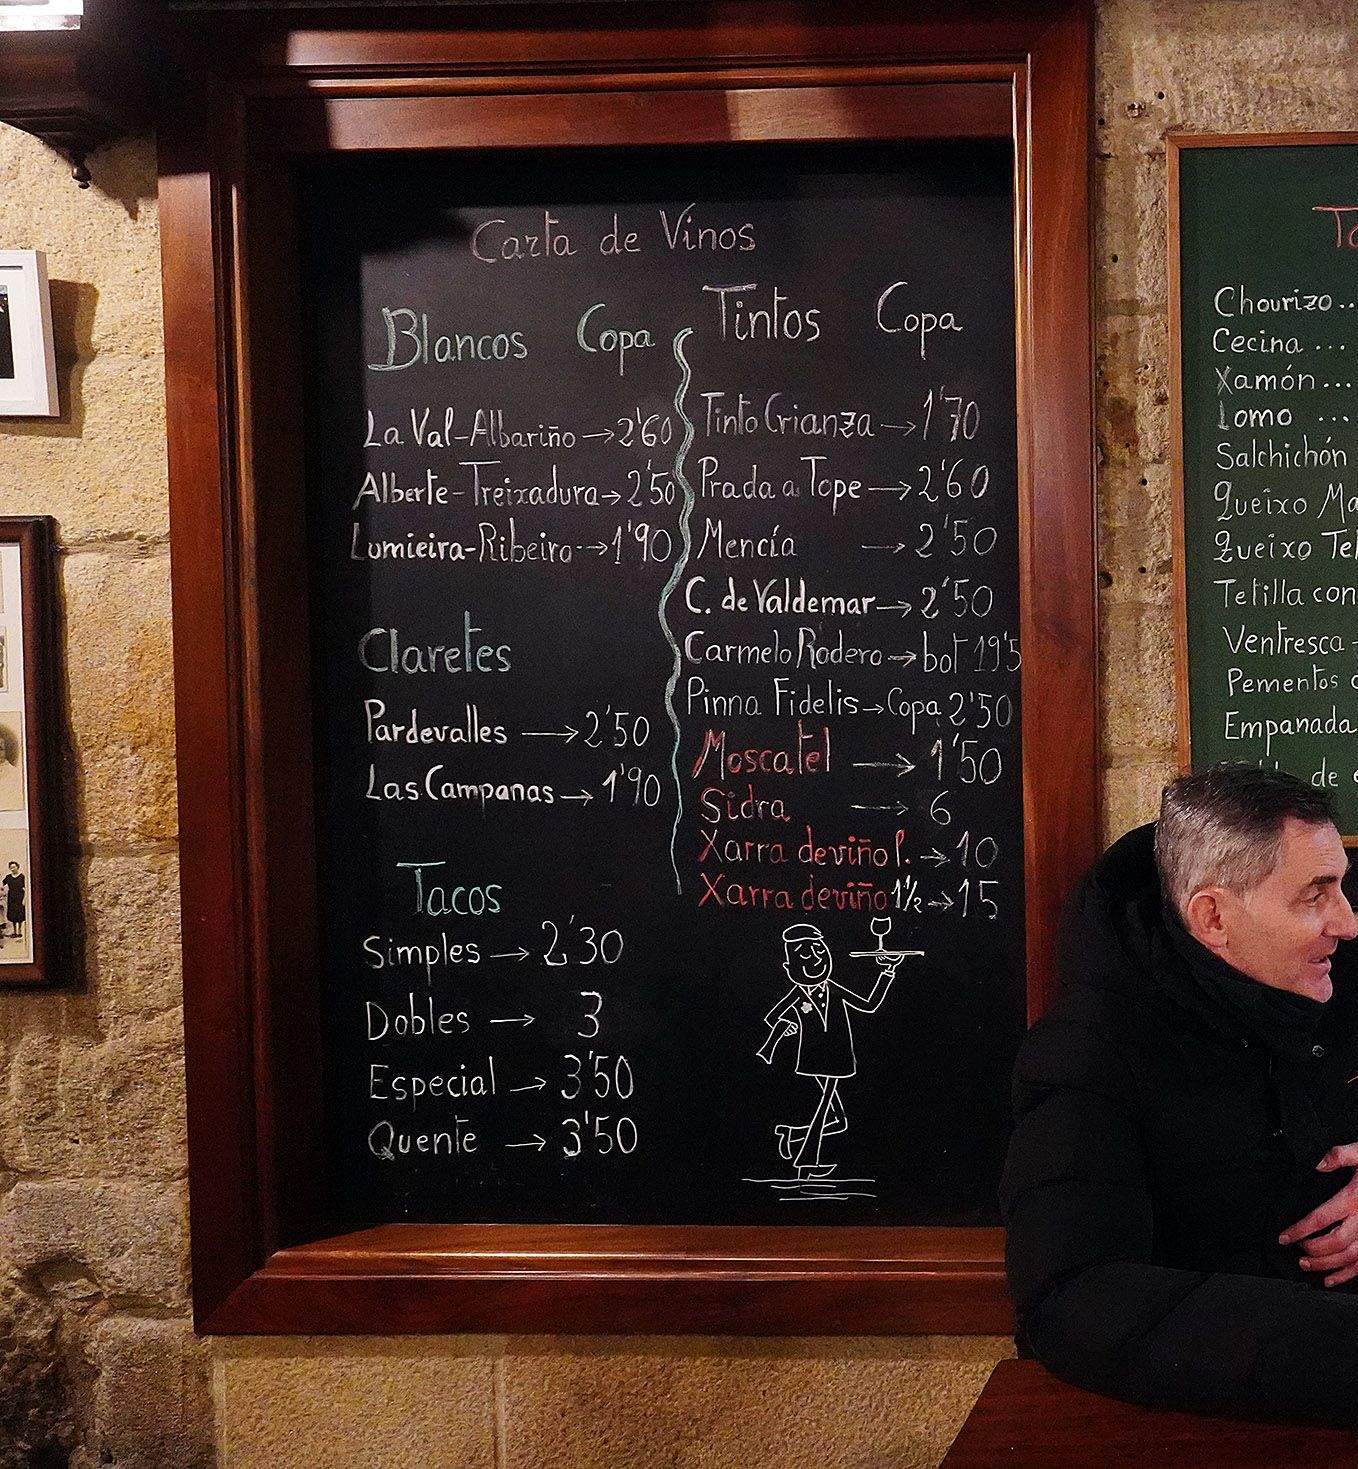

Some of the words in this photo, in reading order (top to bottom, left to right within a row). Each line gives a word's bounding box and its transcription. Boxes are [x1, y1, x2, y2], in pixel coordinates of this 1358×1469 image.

[471, 211, 577, 263] Carta
[600, 213, 641, 255] de
[660, 203, 756, 250] Vinos
[367, 307, 528, 370] Blancos
[576, 303, 656, 376] Copa
[702, 284, 821, 341] Tintos
[877, 281, 963, 360] Copa
[1213, 328, 1303, 354] Cecina
[363, 411, 399, 448] La
[701, 392, 758, 437] Tinto
[765, 393, 875, 438] Crianza
[1217, 400, 1292, 430] Lomo
[1216, 435, 1348, 470] Salchichón
[698, 456, 776, 499] Prada
[784, 479, 800, 497] a
[801, 456, 862, 516] Tope
[697, 517, 798, 560] Mencía
[685, 577, 711, 615] C.
[721, 577, 748, 611] de
[753, 577, 876, 616] Valdemar
[1213, 577, 1305, 607] Tetilla
[1313, 585, 1356, 606] con
[358, 610, 512, 673] Claretes
[684, 629, 792, 665] Carmelo
[796, 628, 882, 669] Rodero
[923, 631, 968, 674] bot
[1222, 620, 1345, 656] Ventresca
[1227, 664, 1338, 696] Pementos
[363, 699, 508, 744] Pardevalles
[583, 704, 650, 748] 2'50
[687, 677, 761, 716] Pinna
[774, 678, 859, 716] Fidelis
[888, 688, 942, 735] Copa
[949, 691, 1013, 729] 2'50
[692, 719, 831, 781] Moscatel
[1224, 706, 1357, 756] Empanada
[366, 764, 419, 800] Las
[425, 765, 555, 815] Campanas
[1311, 757, 1338, 788] de
[700, 784, 791, 824] Sidra
[930, 790, 951, 825] 6
[699, 829, 784, 864] Xarra
[957, 831, 999, 868] 10
[396, 861, 502, 916] Tacos
[699, 872, 793, 908] Xarra
[958, 878, 999, 920] 15
[363, 933, 481, 986] Simples
[542, 915, 624, 966] 2'30
[366, 992, 471, 1041] Dobles
[578, 991, 603, 1038] 3
[370, 1056, 496, 1113] Especial
[561, 1050, 634, 1100] 3'50
[368, 1115, 478, 1160] Quente
[561, 1110, 638, 1158] 3'50
